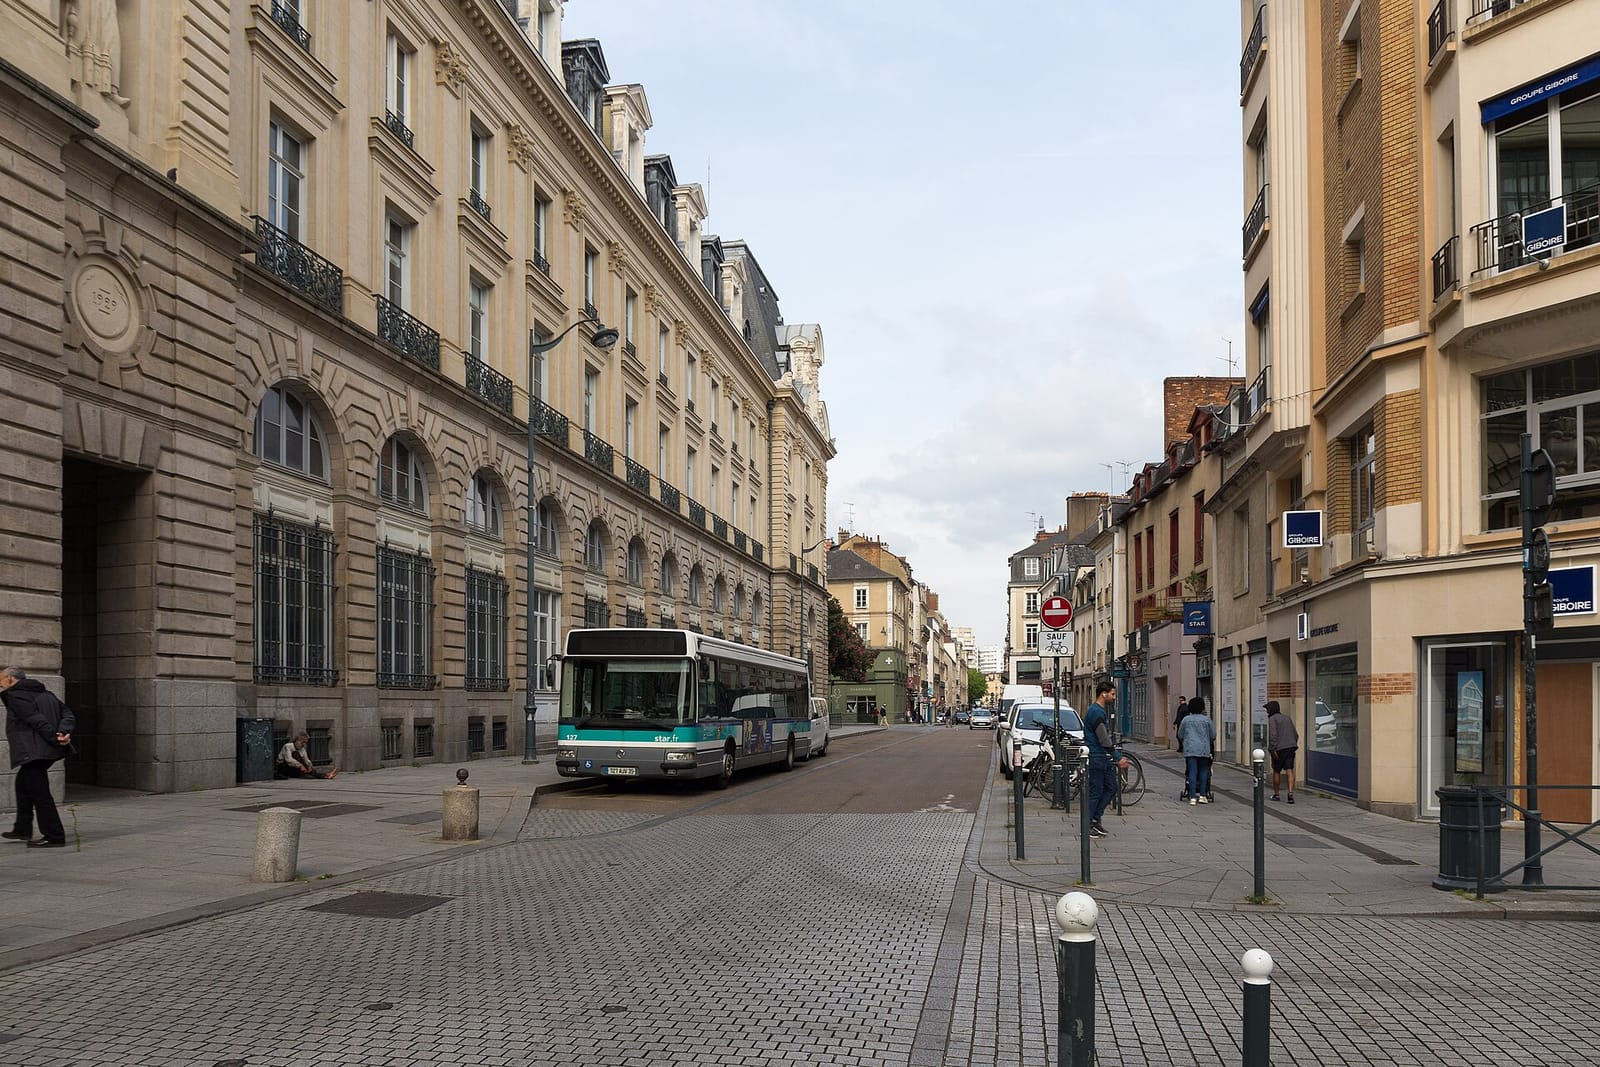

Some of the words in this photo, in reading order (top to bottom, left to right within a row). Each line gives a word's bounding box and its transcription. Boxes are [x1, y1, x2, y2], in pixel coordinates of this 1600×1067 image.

[1510, 86, 1544, 105] GROUPE
[1544, 72, 1579, 91] GIBOIRE
[1526, 235, 1563, 252] GIBOIRE
[1288, 536, 1319, 544] GIBOIRE
[654, 735, 679, 743] star.fr
